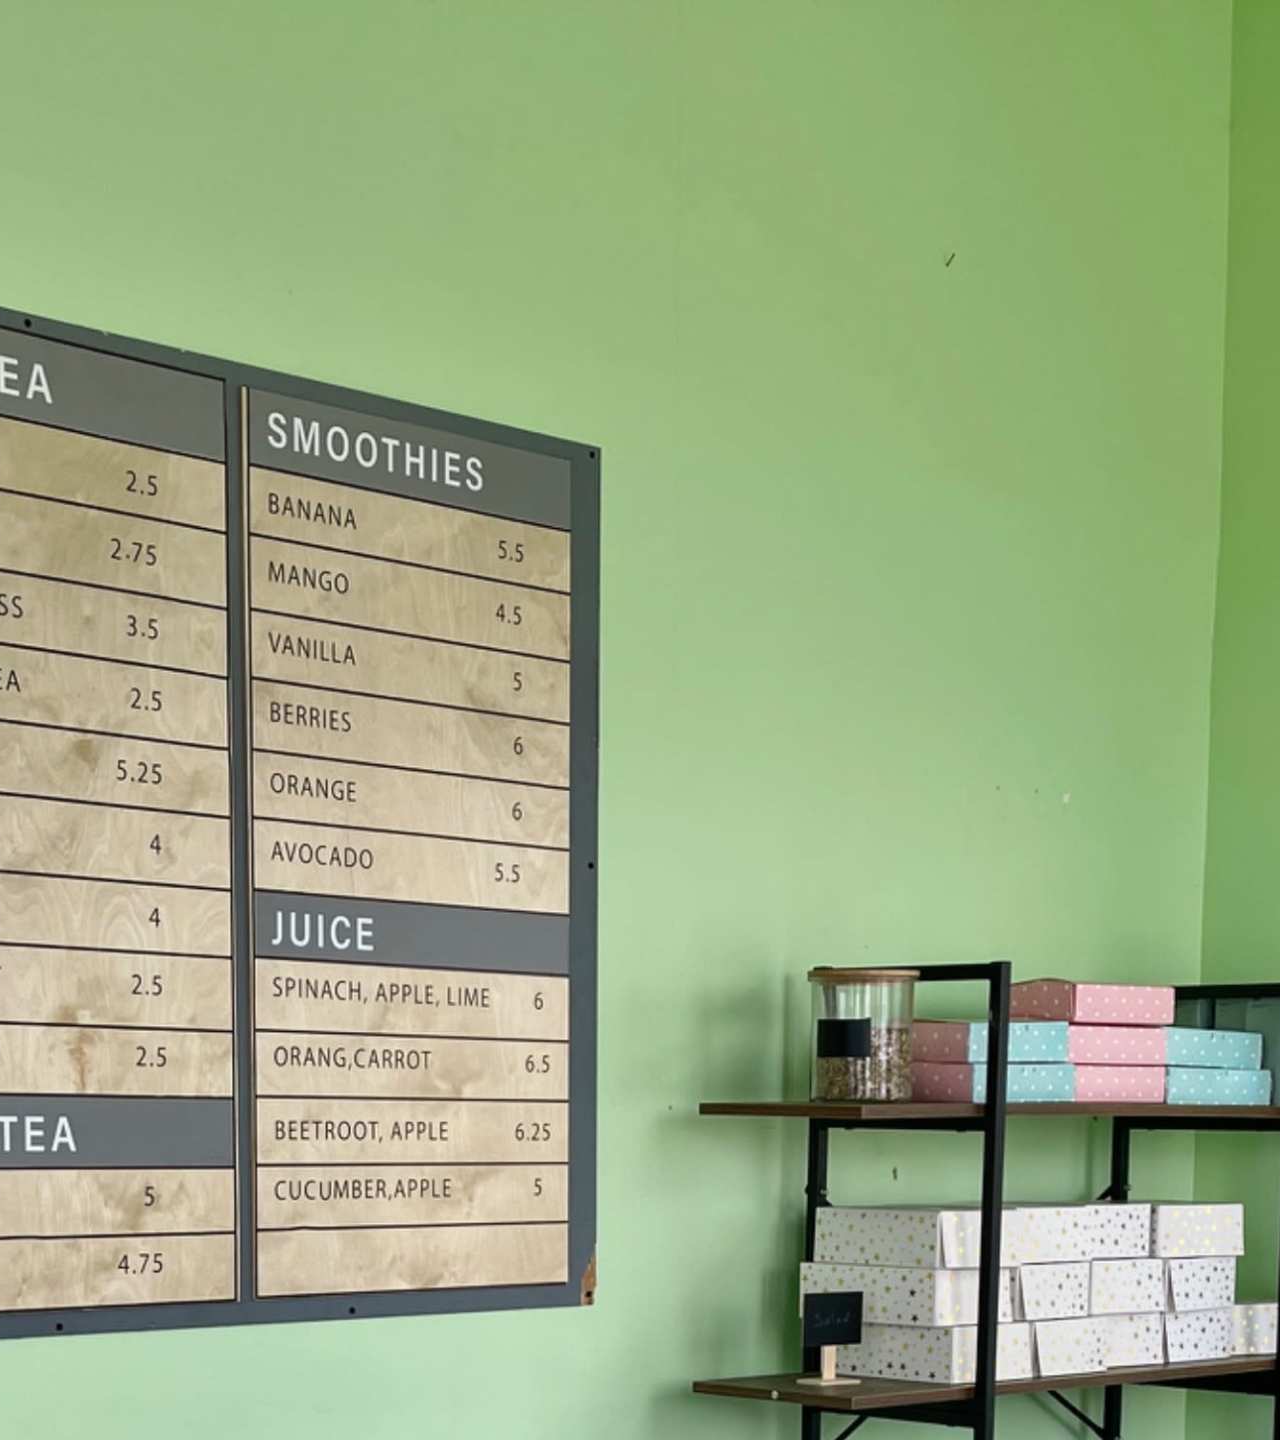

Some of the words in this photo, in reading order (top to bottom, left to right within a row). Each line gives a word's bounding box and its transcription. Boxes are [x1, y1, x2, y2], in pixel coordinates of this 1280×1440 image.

[268, 412, 485, 492] SMOOTHIES
[125, 470, 158, 497] 2.5
[268, 492, 357, 530] BANANA
[498, 540, 524, 563] 5.5
[110, 538, 157, 567] 2.75
[268, 561, 350, 594] MANGO
[496, 603, 523, 626] 4.5
[126, 615, 159, 640] 3.5
[268, 632, 356, 666] VANILLA
[513, 673, 523, 691] 5
[130, 687, 162, 711] 2.5
[270, 702, 351, 732] BERRIES
[513, 737, 523, 756] 6
[116, 760, 162, 785] 5.25
[270, 773, 357, 803] ORANGE
[512, 802, 523, 821] 6
[149, 835, 162, 855] 4
[271, 841, 373, 870] AVOCADO
[495, 863, 521, 884] 5.5
[148, 908, 161, 928] 4
[272, 911, 375, 951] JUICE
[131, 975, 163, 996] 2.5
[272, 977, 369, 1004] SPINACH,
[375, 982, 441, 1007] APPLE,
[446, 987, 490, 1008] LIME
[534, 993, 544, 1011] 6
[136, 1046, 167, 1067] 2.5
[525, 1055, 551, 1074] 6.5
[275, 1120, 384, 1143] BEETROOT,
[391, 1121, 449, 1141] APPLE
[515, 1123, 551, 1142] 6.25
[143, 1186, 155, 1207] 5
[534, 1179, 542, 1197] 5
[117, 1253, 164, 1275] 4.75
